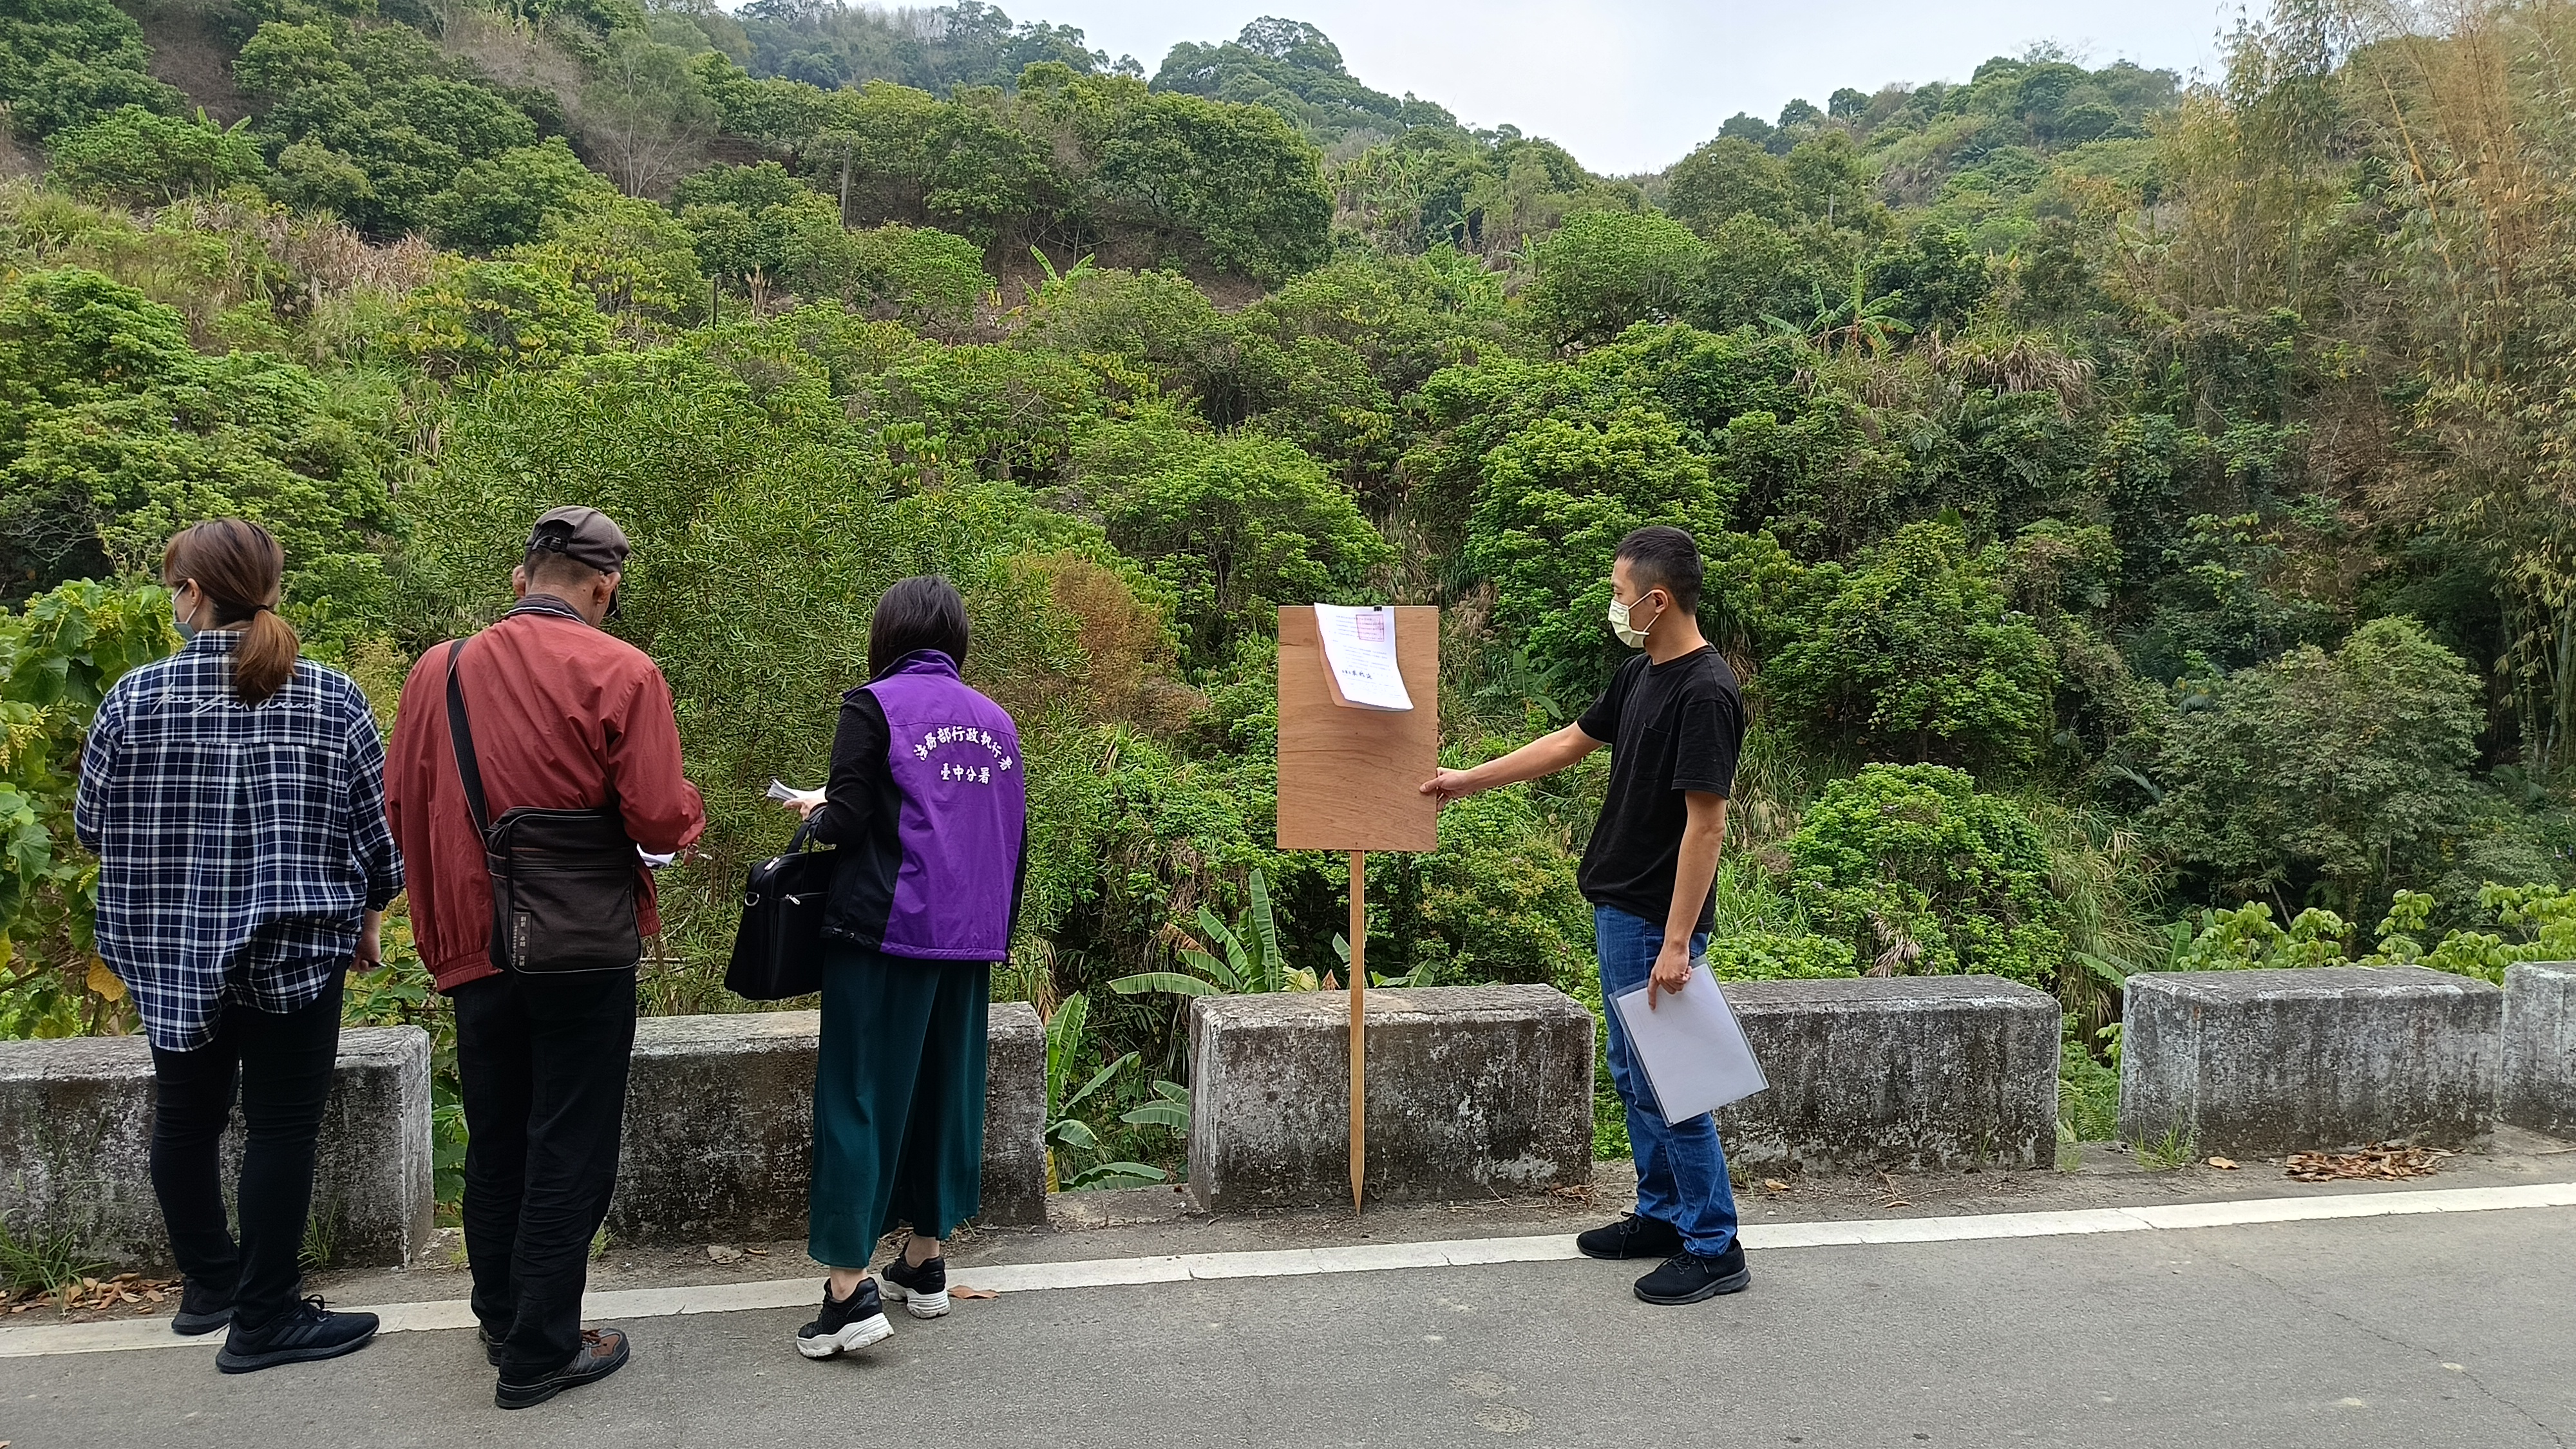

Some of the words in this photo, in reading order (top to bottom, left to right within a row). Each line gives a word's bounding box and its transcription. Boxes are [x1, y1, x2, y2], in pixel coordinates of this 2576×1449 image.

[256, 690, 323, 712] dream
[913, 726, 1013, 772] 法務部行政執行署
[940, 762, 990, 784] 臺中分署
